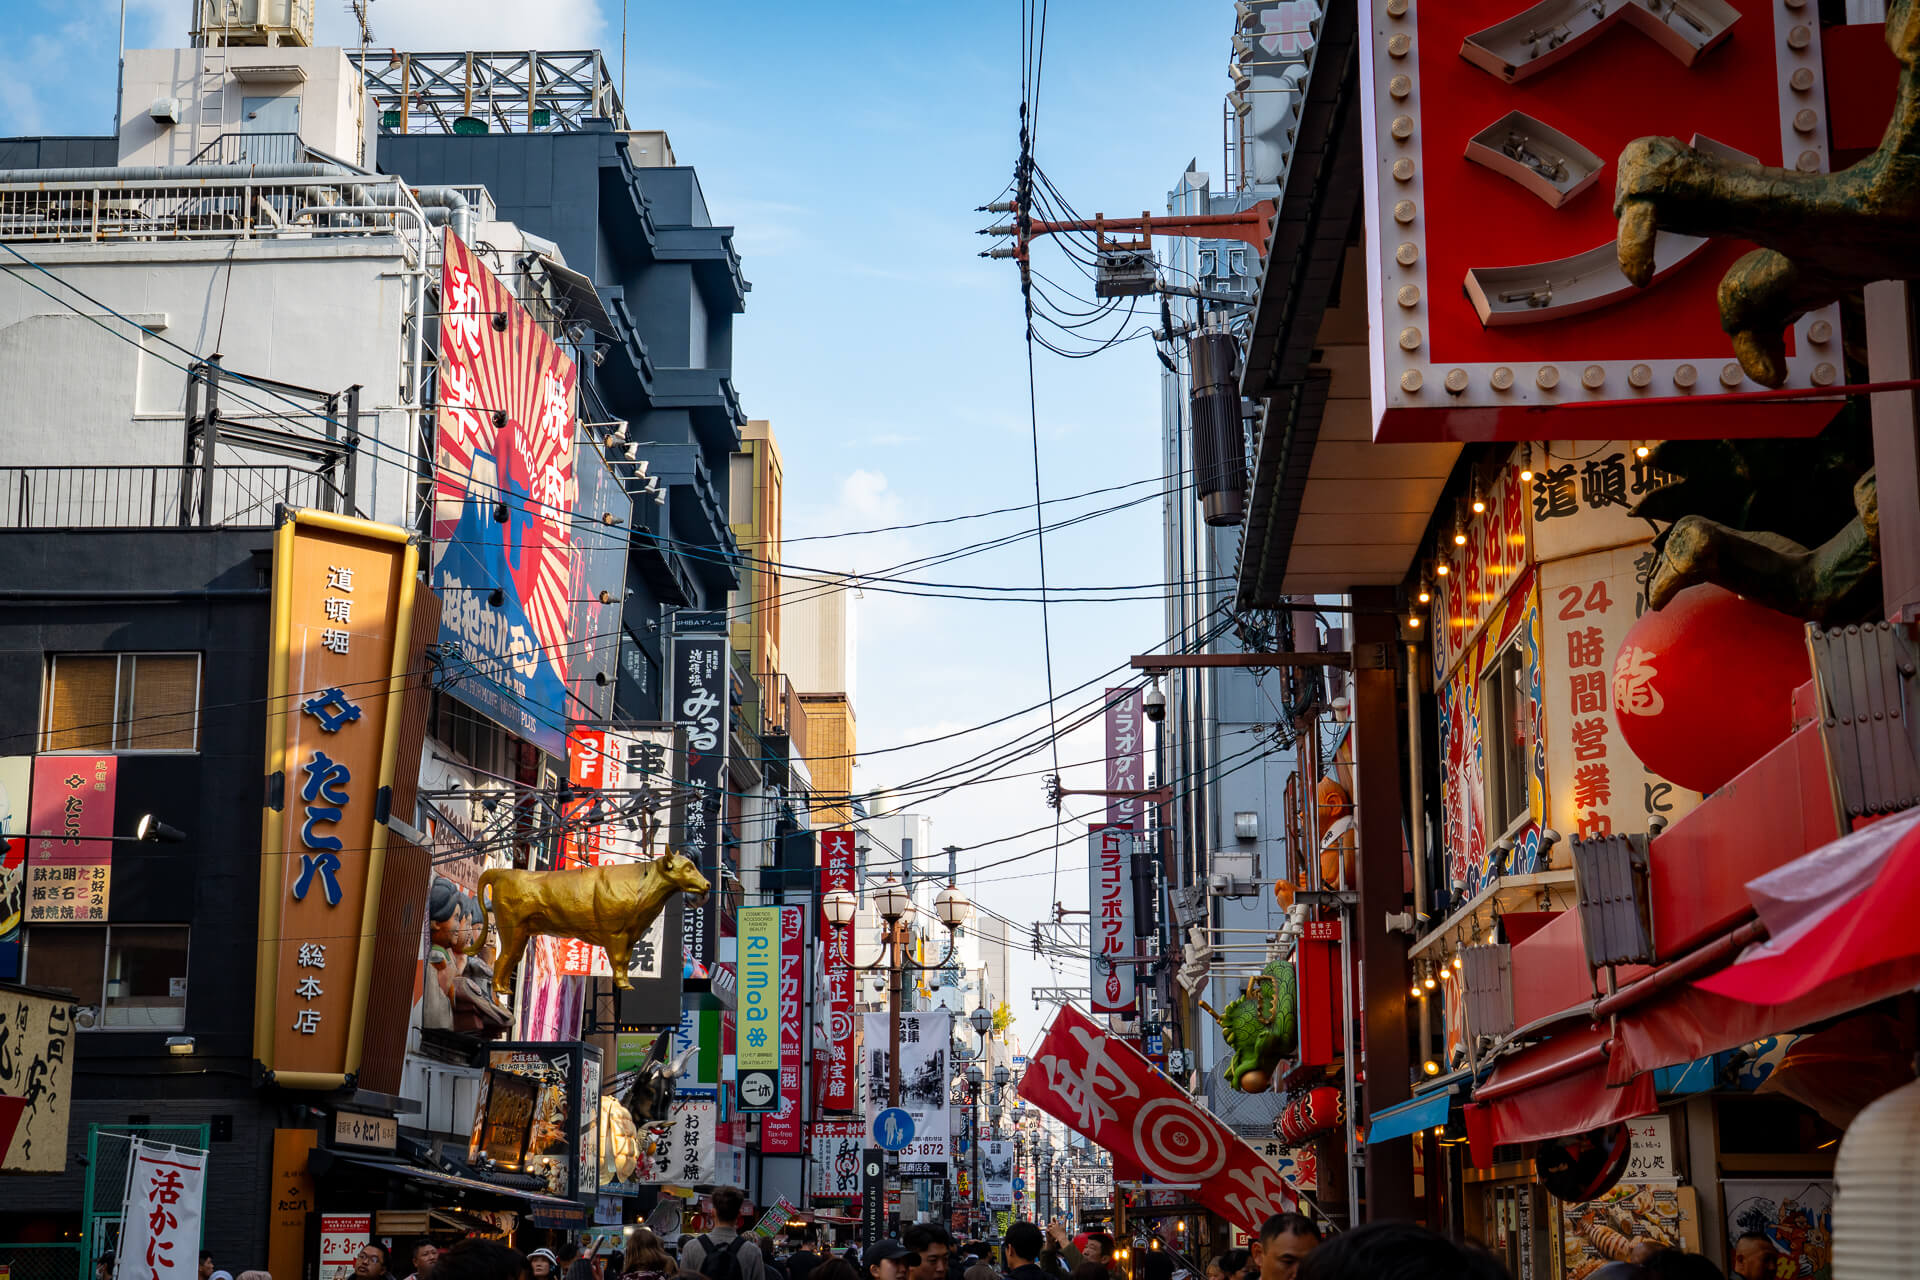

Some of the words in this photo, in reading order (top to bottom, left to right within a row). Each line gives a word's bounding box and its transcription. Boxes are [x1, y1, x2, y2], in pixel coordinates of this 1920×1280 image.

[448, 266, 481, 445] 和牛
[539, 366, 569, 538] 焼肉
[321, 564, 356, 655] 道頓堀
[441, 570, 540, 679] 昭和ホルモン
[520, 711, 537, 734] PLUS
[1557, 580, 1614, 838] 24時間営業中
[1614, 645, 1665, 717] 龍
[578, 738, 599, 779] 3F
[293, 751, 353, 906] たこ八
[30, 867, 48, 920] 鉄板焼
[60, 867, 76, 920] 明石焼
[89, 867, 105, 920] お好み焼
[291, 942, 327, 1034] 総本店
[746, 935, 770, 1022] Rilmoa
[683, 1113, 700, 1181] お好み焼
[835, 1138, 859, 1192] 射的
[146, 1168, 185, 1280] 活かに
